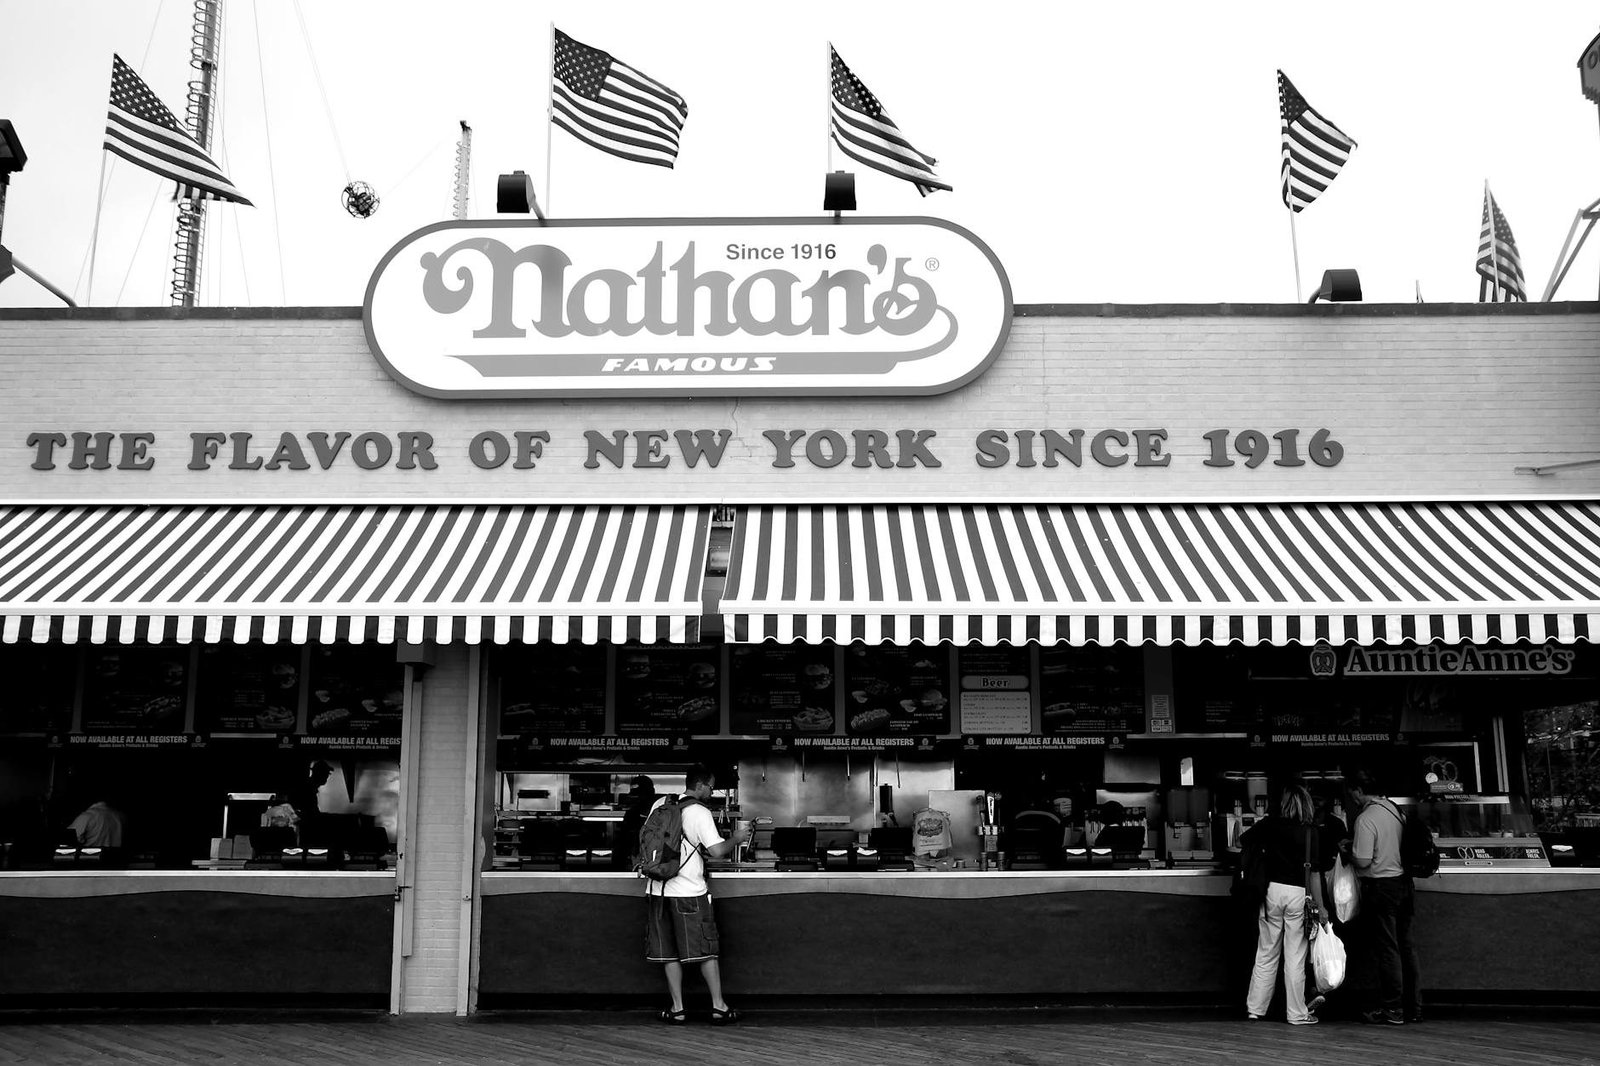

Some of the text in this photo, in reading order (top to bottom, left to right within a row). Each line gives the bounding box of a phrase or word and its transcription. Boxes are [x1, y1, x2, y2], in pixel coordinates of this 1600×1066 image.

[726, 243, 837, 260] Since 1916
[420, 237, 940, 338] Nathan's
[601, 356, 777, 373] FAMOUS
[26, 427, 1345, 471] THE FLAVOR OF NEW YORK SINCE 1916
[982, 677, 1008, 687] Beer
[70, 736, 188, 744] NOW AVAILABLE AT ALL REGISTERS
[300, 736, 400, 746] NOW AVAILABLE AT ALL REGIS
[550, 738, 670, 746] NOW AVAILABLE AT ALL REGISTERS
[794, 738, 914, 746] NOW AVAILABLE AT ALL REGISTERS
[986, 737, 1106, 745] NOW AVAILABLE AT ALL REGISTERS
